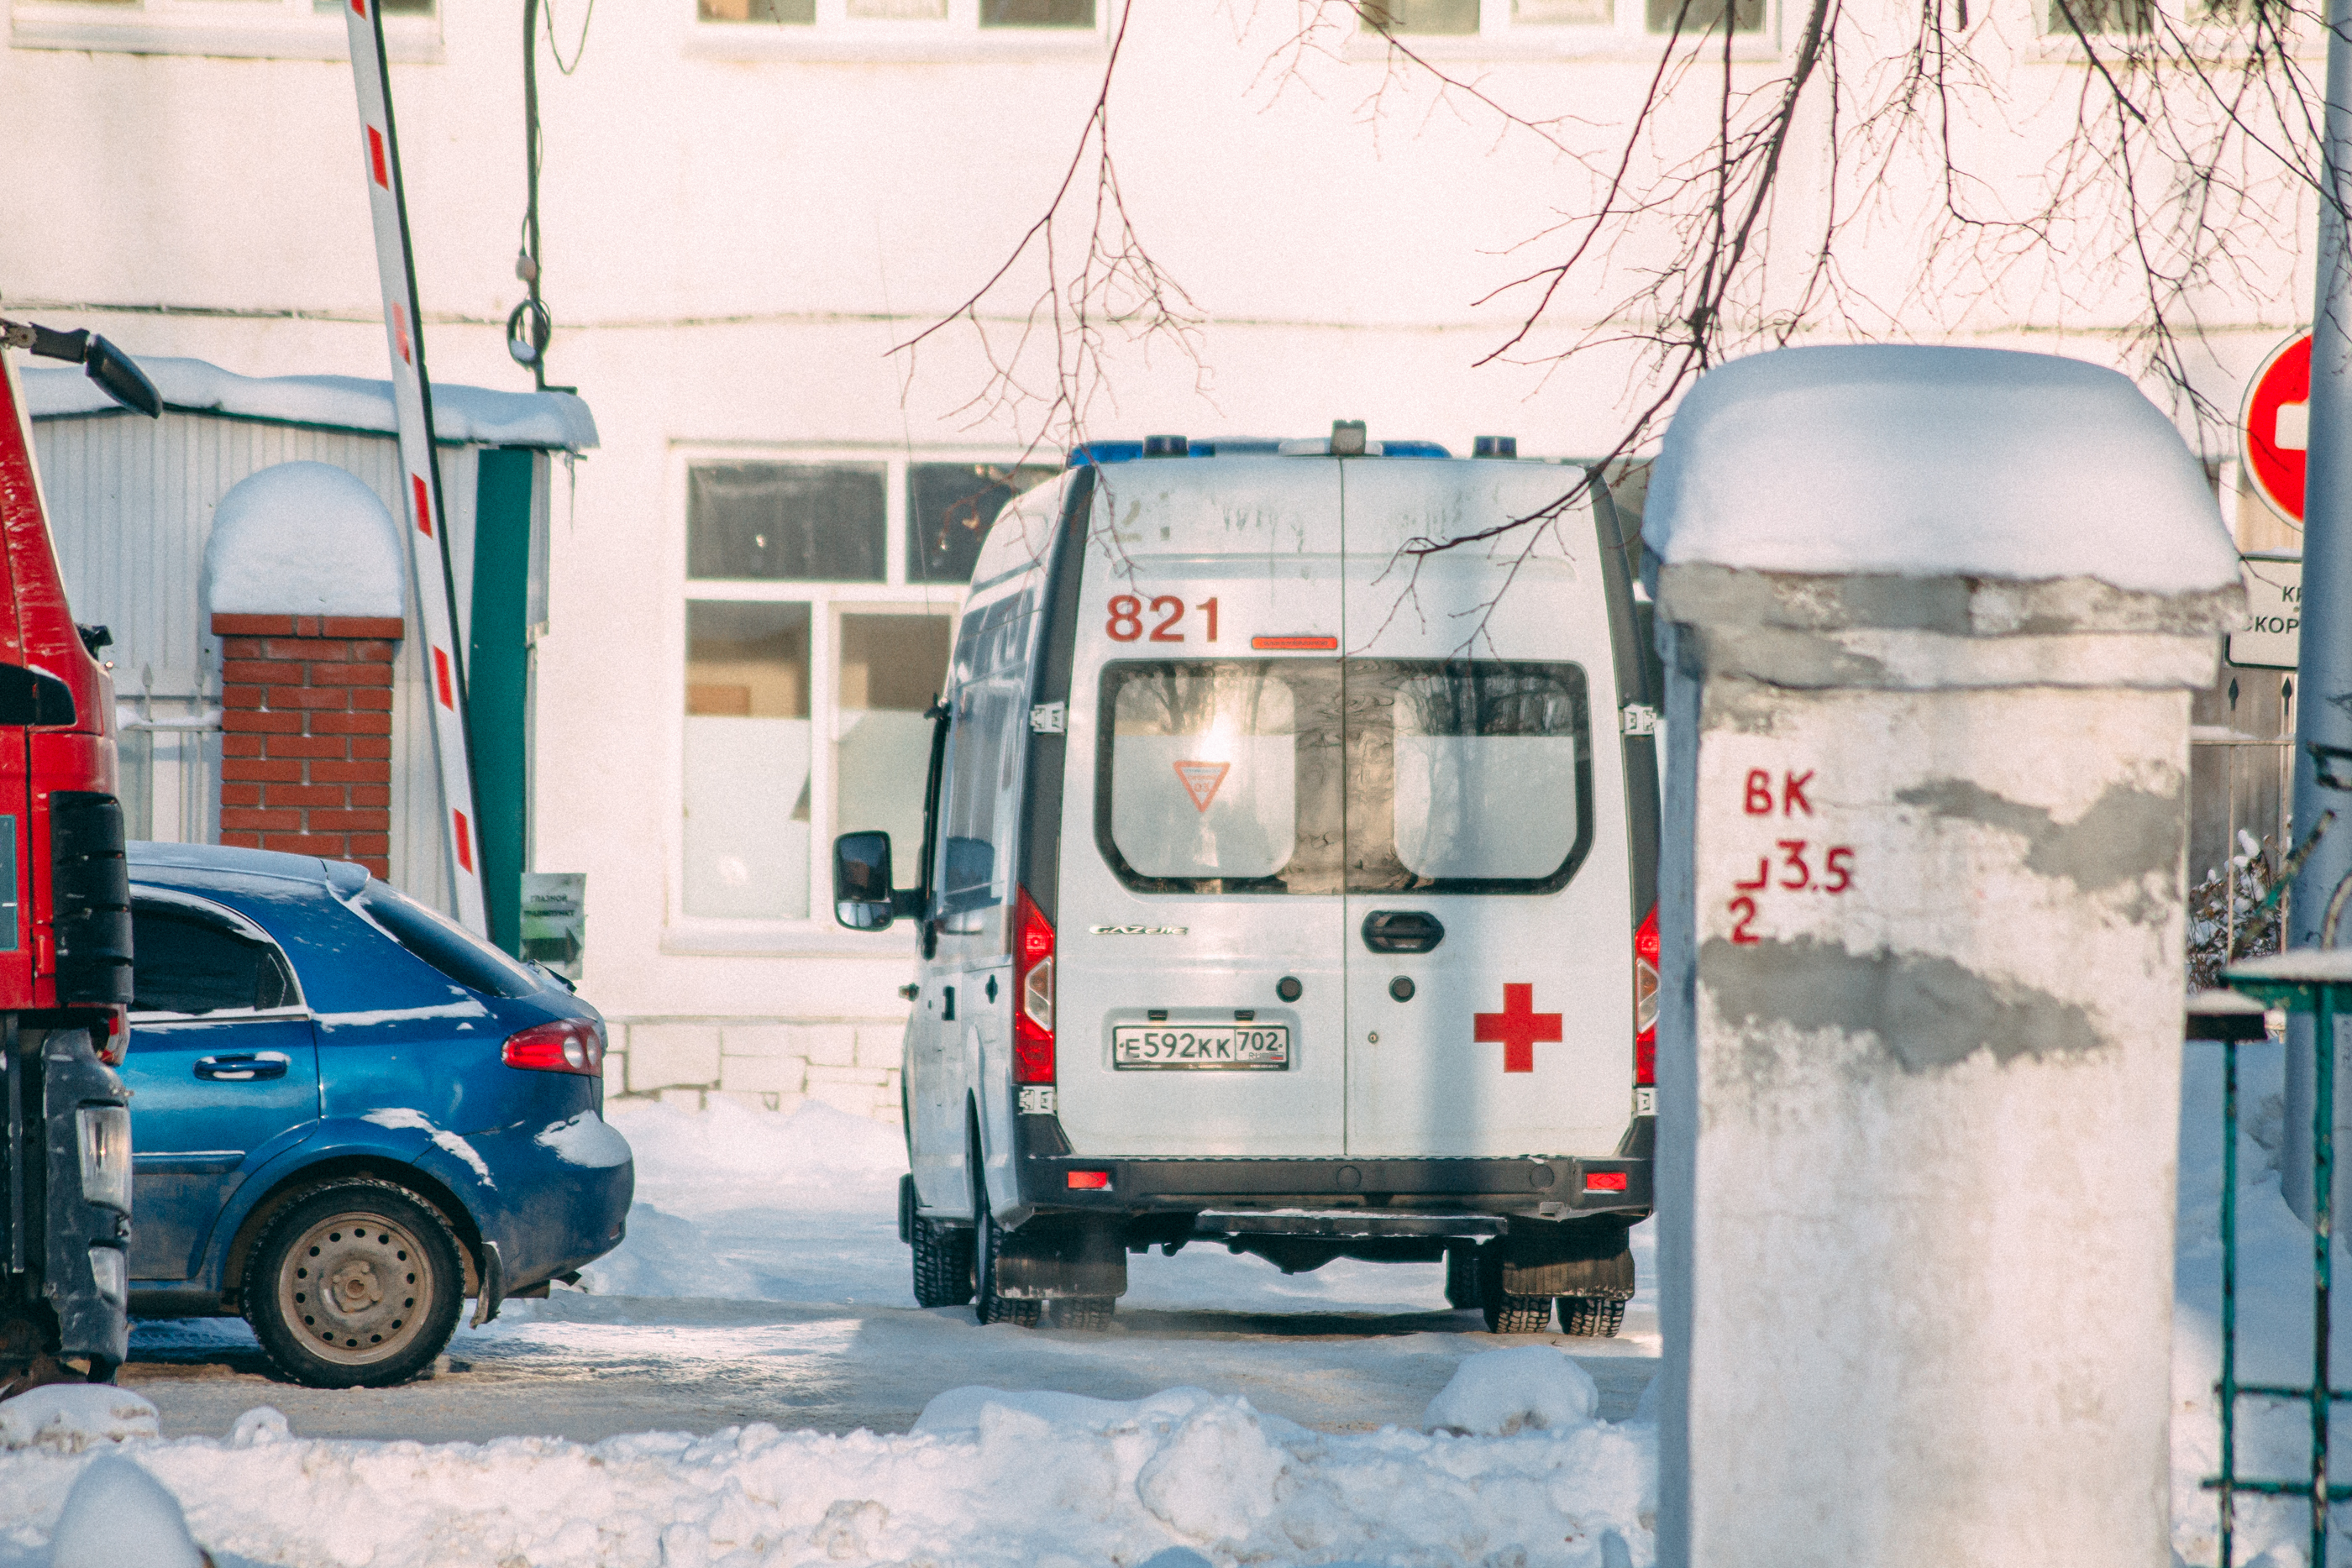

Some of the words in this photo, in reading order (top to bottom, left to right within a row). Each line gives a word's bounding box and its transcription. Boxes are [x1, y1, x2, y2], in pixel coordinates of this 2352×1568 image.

[1105, 594, 1218, 643] 821
[1745, 768, 1814, 817] ВК
[530, 894, 568, 903] ГЛАЗНОЙ
[1237, 1031, 1278, 1051] 702
